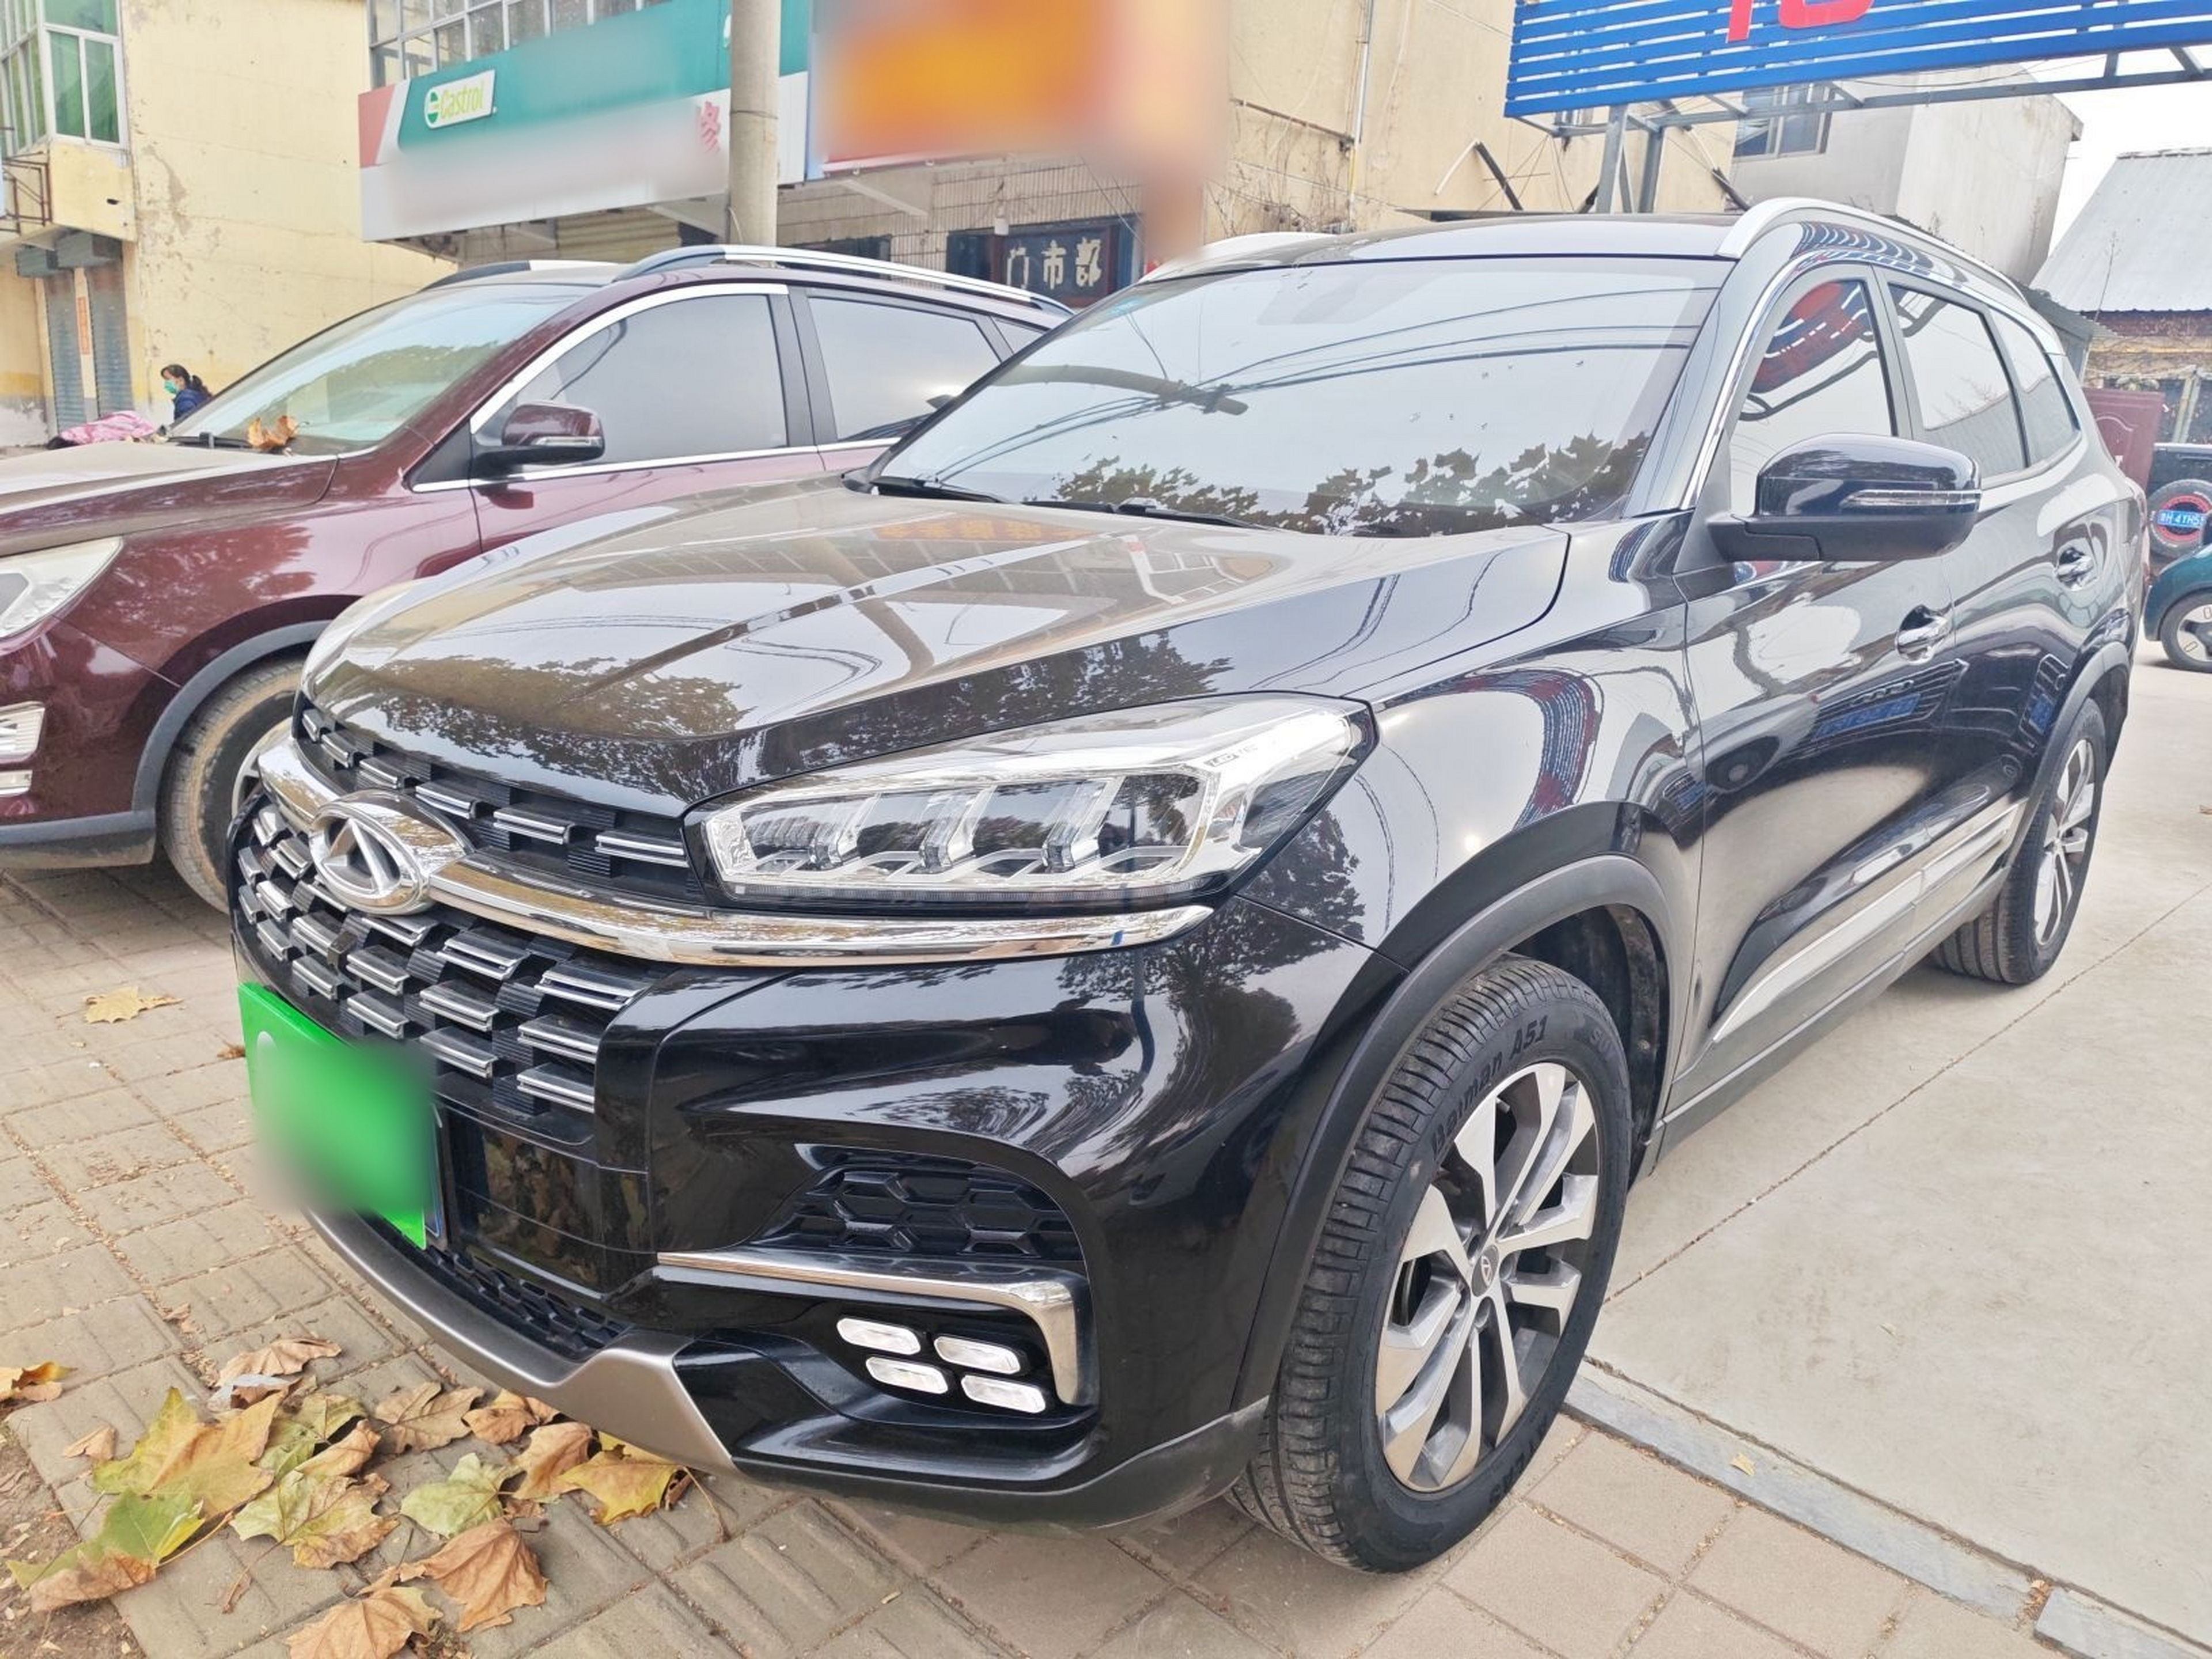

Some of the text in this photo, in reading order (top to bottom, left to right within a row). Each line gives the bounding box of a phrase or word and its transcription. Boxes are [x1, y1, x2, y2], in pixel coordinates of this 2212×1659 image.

[440, 81, 484, 119] Castrol
[1006, 237, 1103, 290] 门市部
[1510, 1014, 1548, 1059] A51
